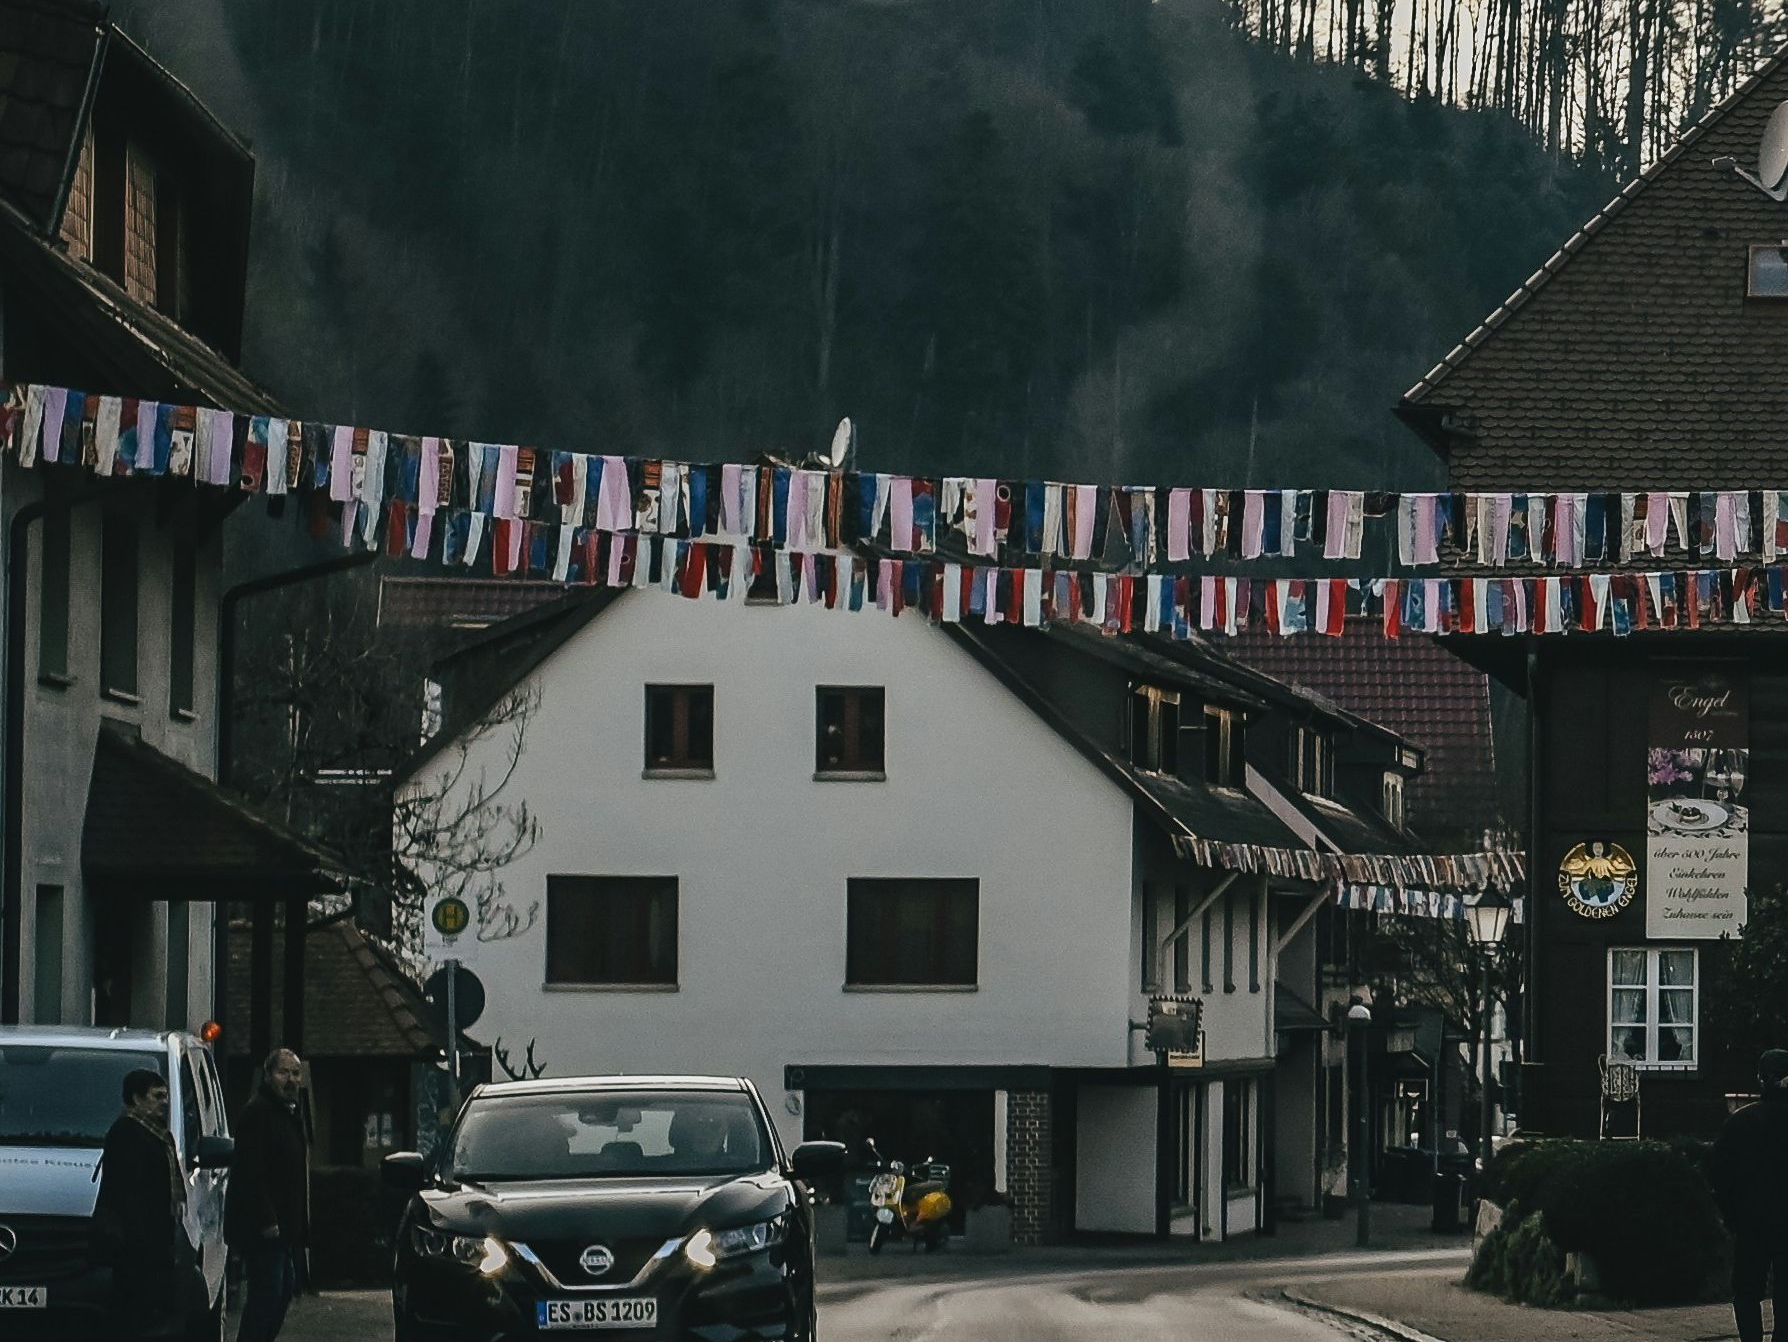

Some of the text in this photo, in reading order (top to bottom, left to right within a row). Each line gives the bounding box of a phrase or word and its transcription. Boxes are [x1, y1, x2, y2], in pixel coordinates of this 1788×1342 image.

[1668, 686, 1731, 718] Engel
[1558, 873, 1638, 919] ZUM GOLDENEN ENGEL
[0, 1288, 39, 1306] K 14
[548, 1301, 655, 1323] ES BS 1209
